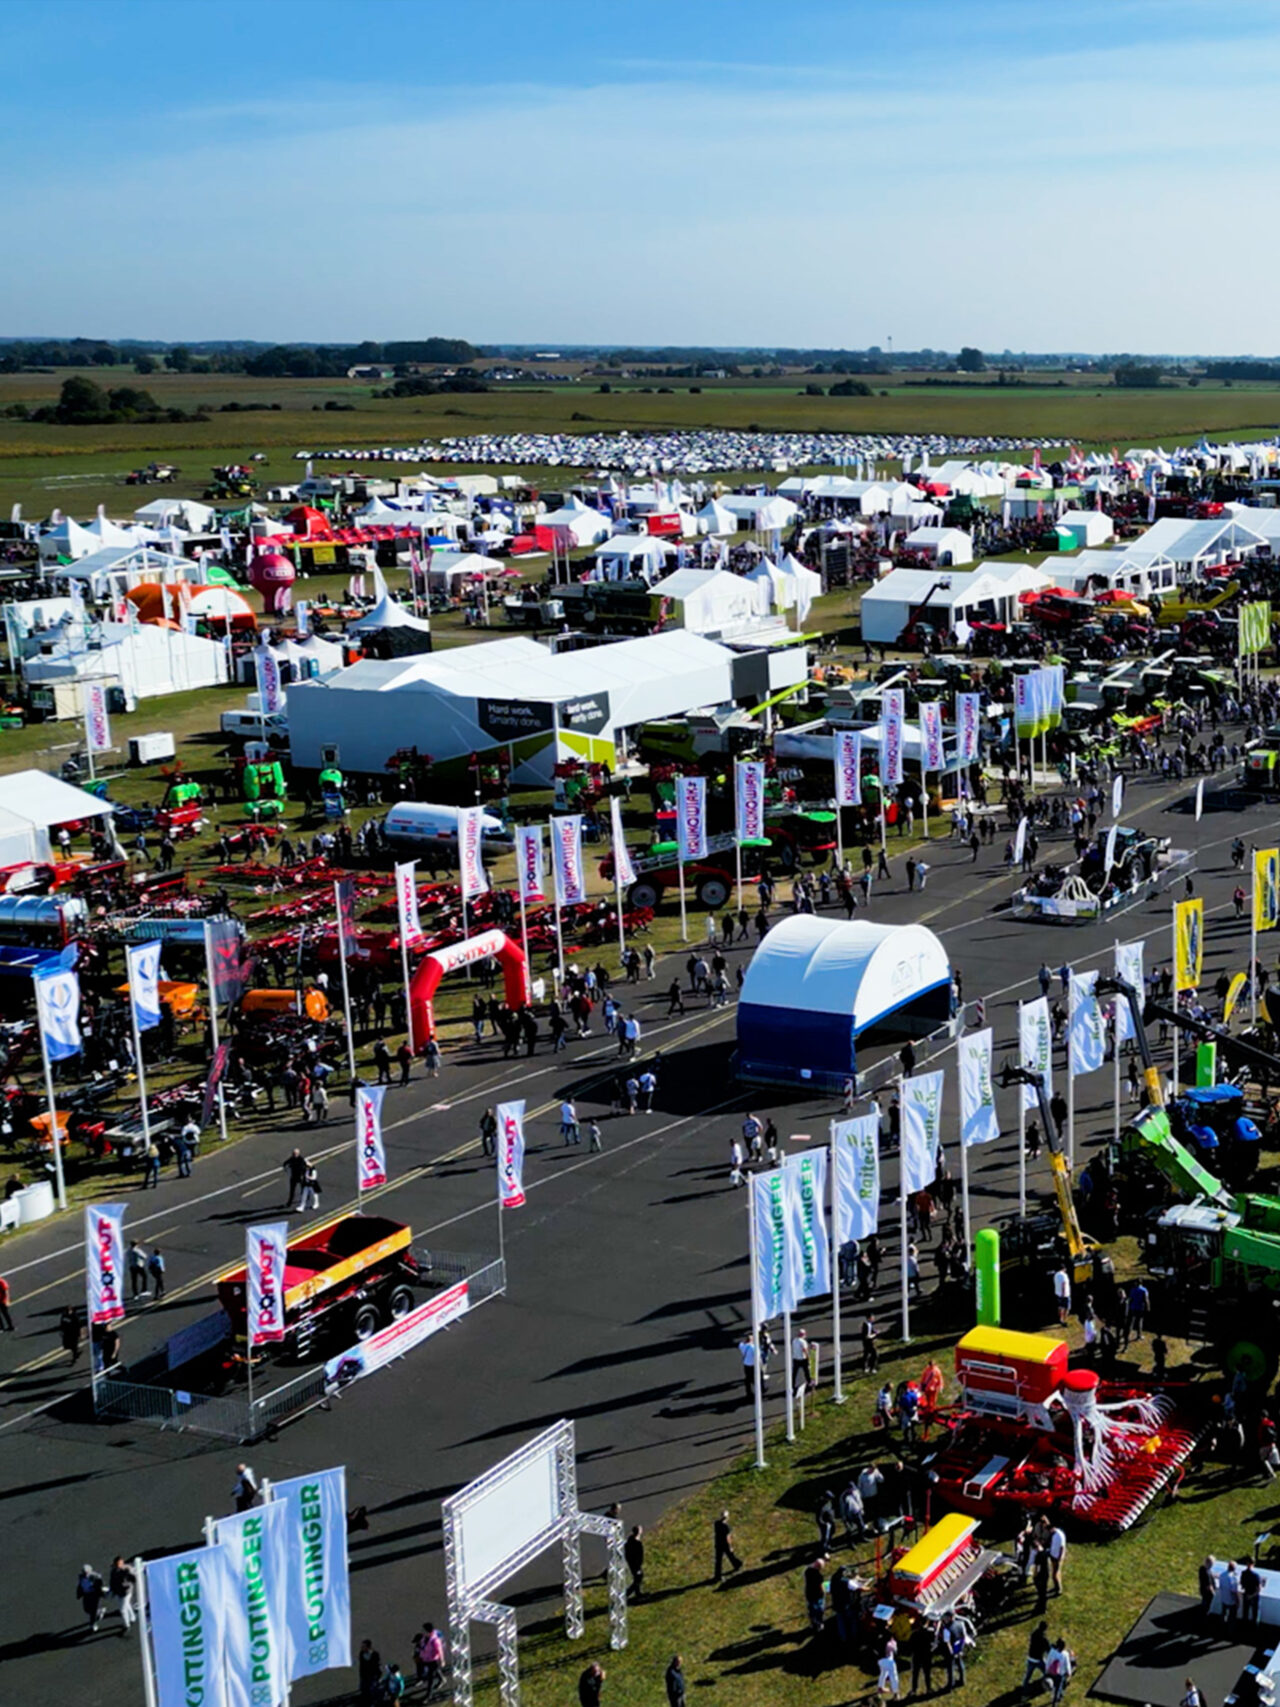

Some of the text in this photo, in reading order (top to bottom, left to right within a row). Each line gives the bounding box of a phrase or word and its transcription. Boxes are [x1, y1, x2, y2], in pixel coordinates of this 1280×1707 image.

[844, 740, 856, 801] KRUKOWIAK
[688, 788, 700, 855] KRUKOWIAK
[747, 773, 758, 836] KRUKOWIAK
[464, 819, 479, 890] KRUKOWIAK
[563, 827, 577, 899] KRUKOWIAK
[1037, 1015, 1048, 1071] Raitech
[859, 1136, 875, 1200] Raitech
